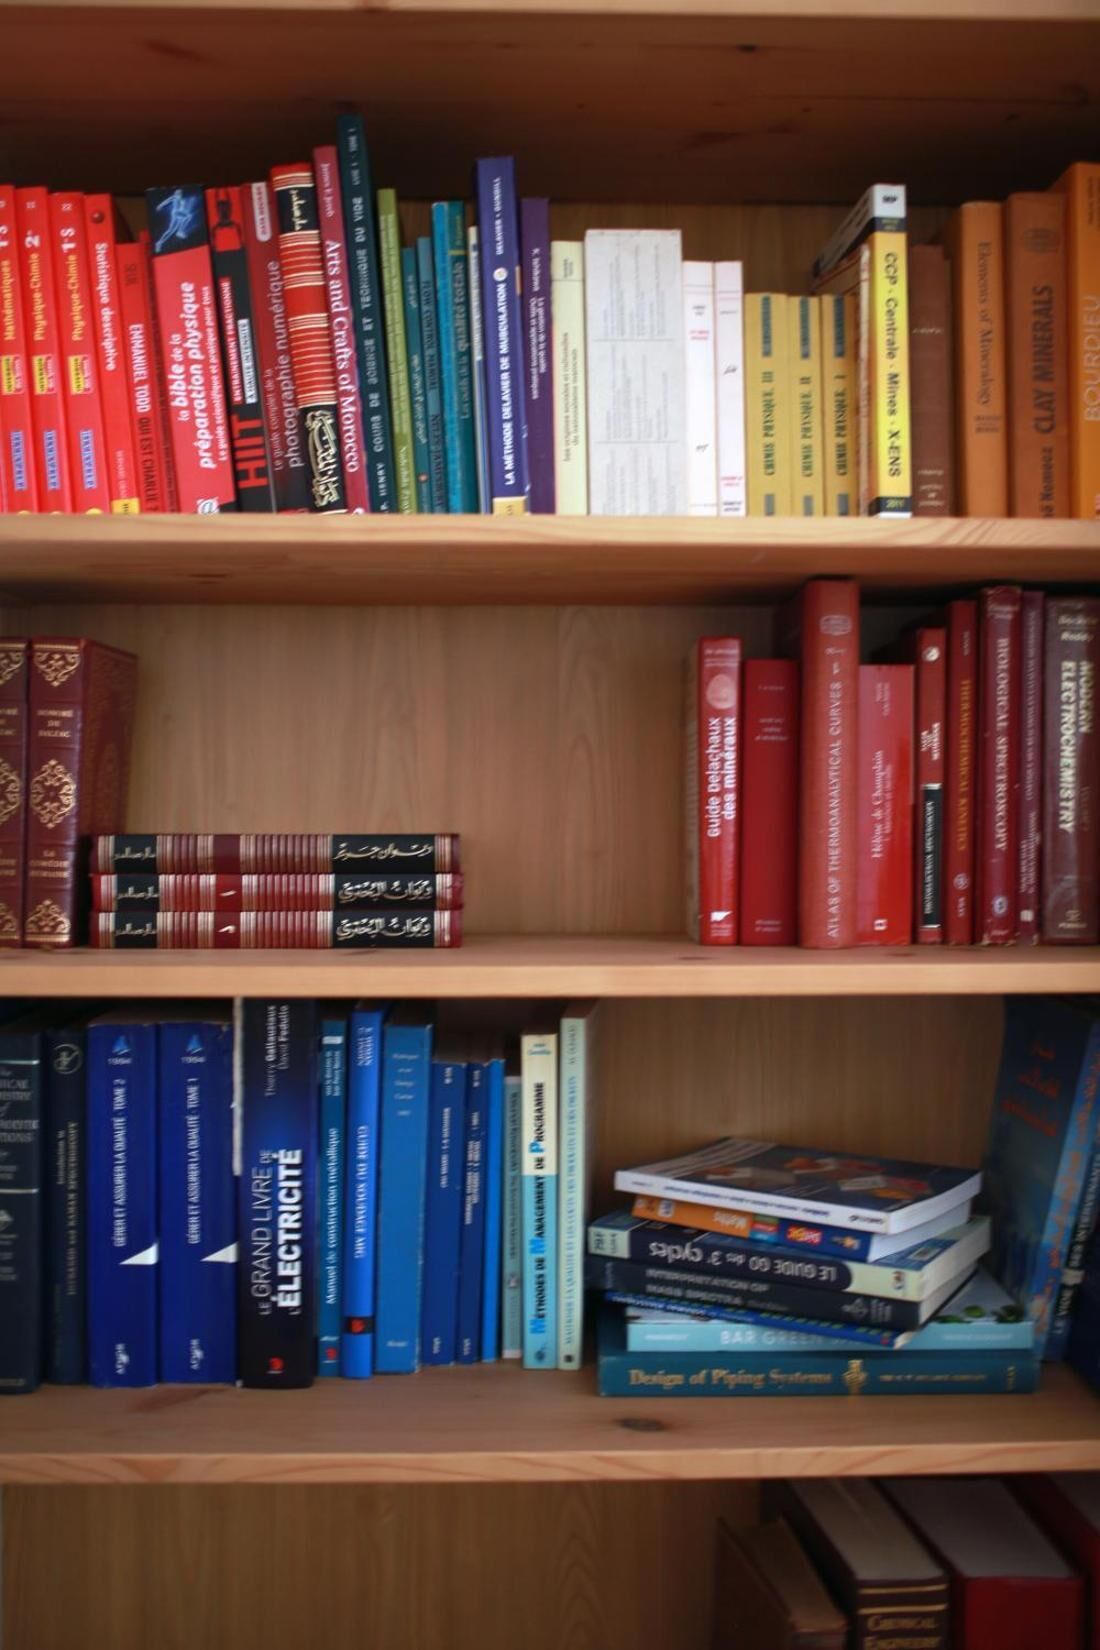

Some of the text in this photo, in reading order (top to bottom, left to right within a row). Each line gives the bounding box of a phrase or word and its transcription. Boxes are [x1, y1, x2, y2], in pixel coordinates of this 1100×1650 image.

[351, 196, 364, 221] VIDE
[354, 226, 365, 242] DU
[356, 250, 373, 309] TECHNIQUE
[452, 261, 465, 303] totale
[977, 241, 991, 302] Elements
[29, 253, 47, 341] Physique-Chimie
[66, 254, 85, 341] Physique-Chimie
[95, 242, 117, 372] Statistique descriptive
[201, 286, 210, 306] tous
[204, 307, 215, 326] pour
[978, 307, 989, 323] of
[362, 317, 373, 330] ET
[453, 304, 471, 352] qualité
[496, 283, 509, 354] MUSCULATION
[205, 327, 219, 362] pratique
[266, 260, 305, 469] photographie numérique
[324, 239, 361, 473] Arts and Crafts of Morocco
[364, 338, 378, 384] SCIENCE
[499, 355, 510, 370] DE
[884, 253, 902, 477] CCP Centrale Mines X-ENS
[1031, 284, 1055, 435] CLAY MINERALS
[1081, 295, 1100, 422] BOURDIEU
[167, 333, 190, 421] la bible de la
[179, 282, 216, 469] préparation physique
[209, 364, 217, 374] et
[264, 368, 274, 379] la
[265, 380, 275, 393] de
[977, 326, 993, 407] Mineralogy
[129, 323, 157, 504] EMMANUEL TODD QUI EST CHARLIE
[209, 375, 225, 424] scientifique
[265, 394, 281, 430] complet
[369, 392, 380, 407] DE
[500, 371, 511, 420] DELAVIER
[214, 426, 228, 450] guide
[231, 414, 268, 489] HIIT
[270, 431, 284, 458] guide
[371, 415, 384, 452] COURS
[500, 421, 514, 470] MÉTHODE
[504, 471, 515, 485] LA
[762, 442, 775, 476] CHIMIE
[801, 443, 813, 478] CHIMIE
[835, 441, 848, 476] CHIMIE
[995, 637, 1009, 731] BIOLOGICAL
[1078, 660, 1094, 734] MODERN
[718, 716, 737, 820] des minéraux
[956, 679, 972, 851] THERMOCHEMICAL KINETICS
[1059, 661, 1077, 833] ELECTROCHEMISTRY
[704, 717, 723, 838] Guide Delachaux
[870, 749, 885, 805] Champlain
[994, 735, 1010, 851] SPECTROSCOPY
[827, 681, 843, 939] ATLAS OF THERMOANALYTICAL CURVES
[870, 806, 884, 820] de
[113, 1086, 125, 1110] TOME
[186, 1085, 199, 1108] TOME
[112, 1116, 127, 1151] QUALITÉ
[185, 1114, 200, 1149] QUALITÉ
[113, 1152, 126, 1163] LA
[187, 1150, 200, 1161] LA
[113, 1164, 126, 1206] ASSURER
[187, 1162, 200, 1203] ASSURER
[354, 1125, 368, 1259] GUIDE DU SOUDAGE MIG
[113, 1207, 126, 1218] ET
[187, 1204, 200, 1215] ET
[323, 1127, 340, 1304] Manuel de construction métallique
[527, 1082, 547, 1335] MÉTHODES DE MANAGEMENT DE PROGRAMME
[112, 1219, 127, 1247] GÉRER
[186, 1216, 200, 1244] GÉRER
[252, 1149, 273, 1315] LE GRAND LIVRE DE
[648, 1241, 837, 1282] LE GUIDE GO des cycles
[720, 1331, 754, 1345] BAR
[629, 1368, 832, 1388] Design of Piping Systems
